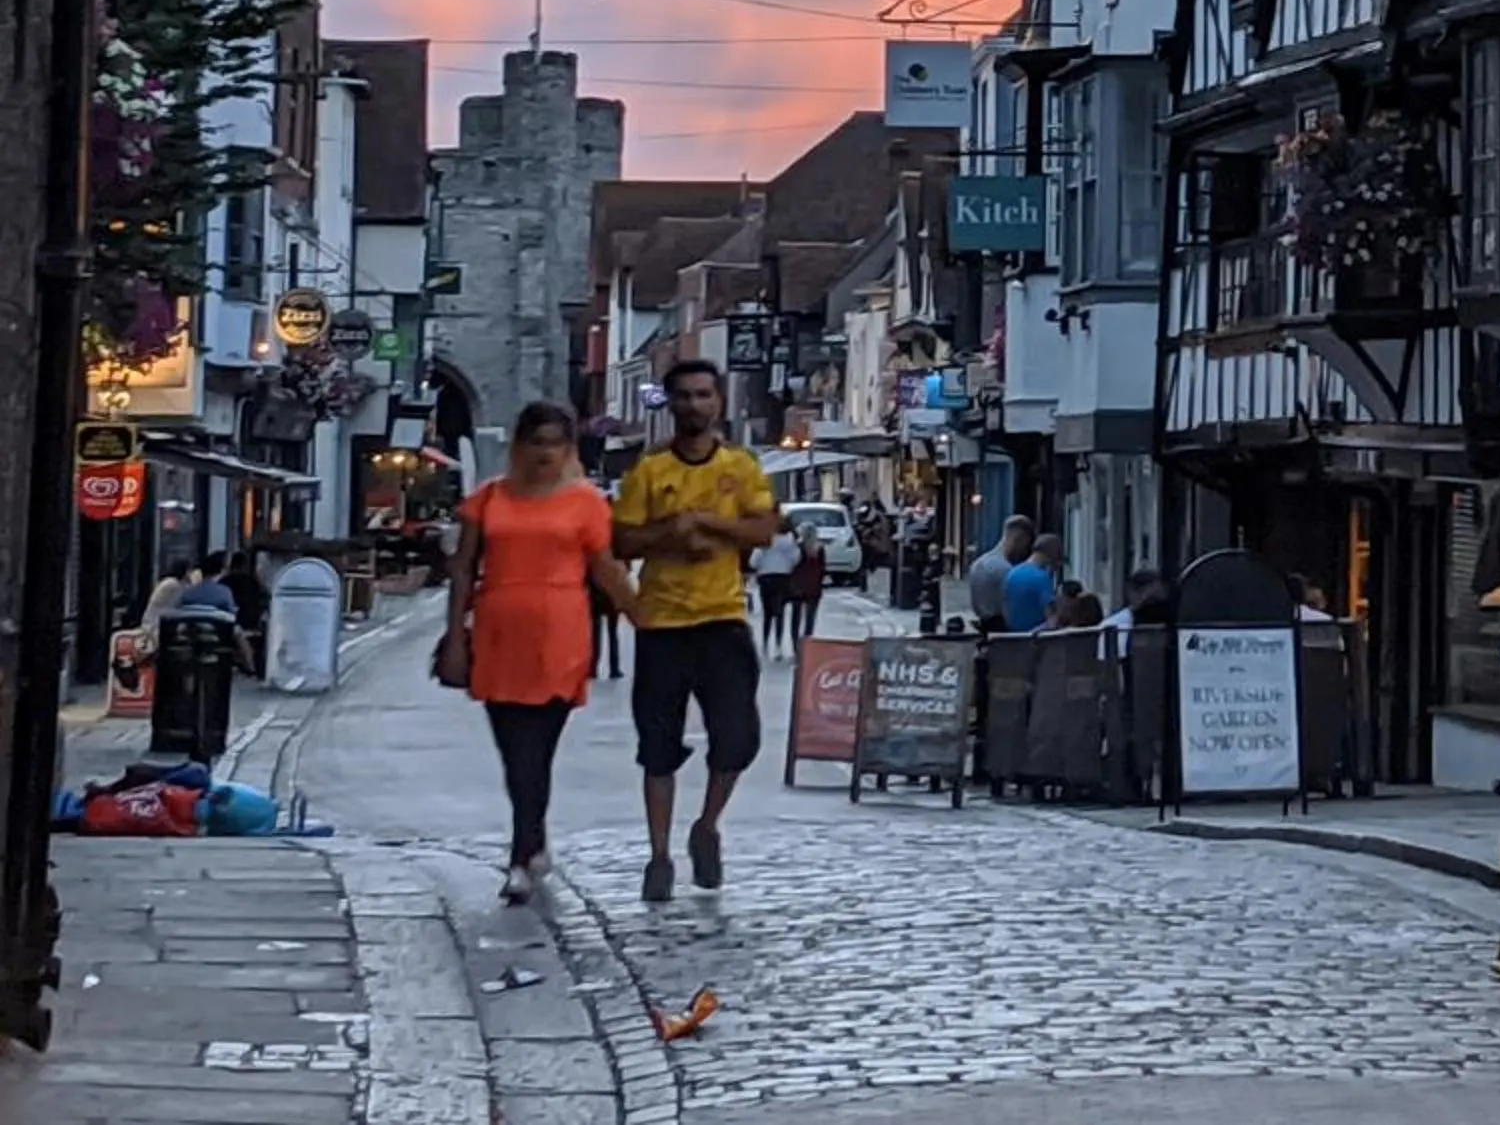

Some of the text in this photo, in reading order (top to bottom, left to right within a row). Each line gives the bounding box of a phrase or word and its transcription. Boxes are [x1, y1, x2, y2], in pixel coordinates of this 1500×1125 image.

[956, 195, 1039, 225] Kitch
[879, 660, 936, 685] NHS
[876, 696, 956, 715] SERVICES
[1201, 709, 1279, 728] GARDEN
